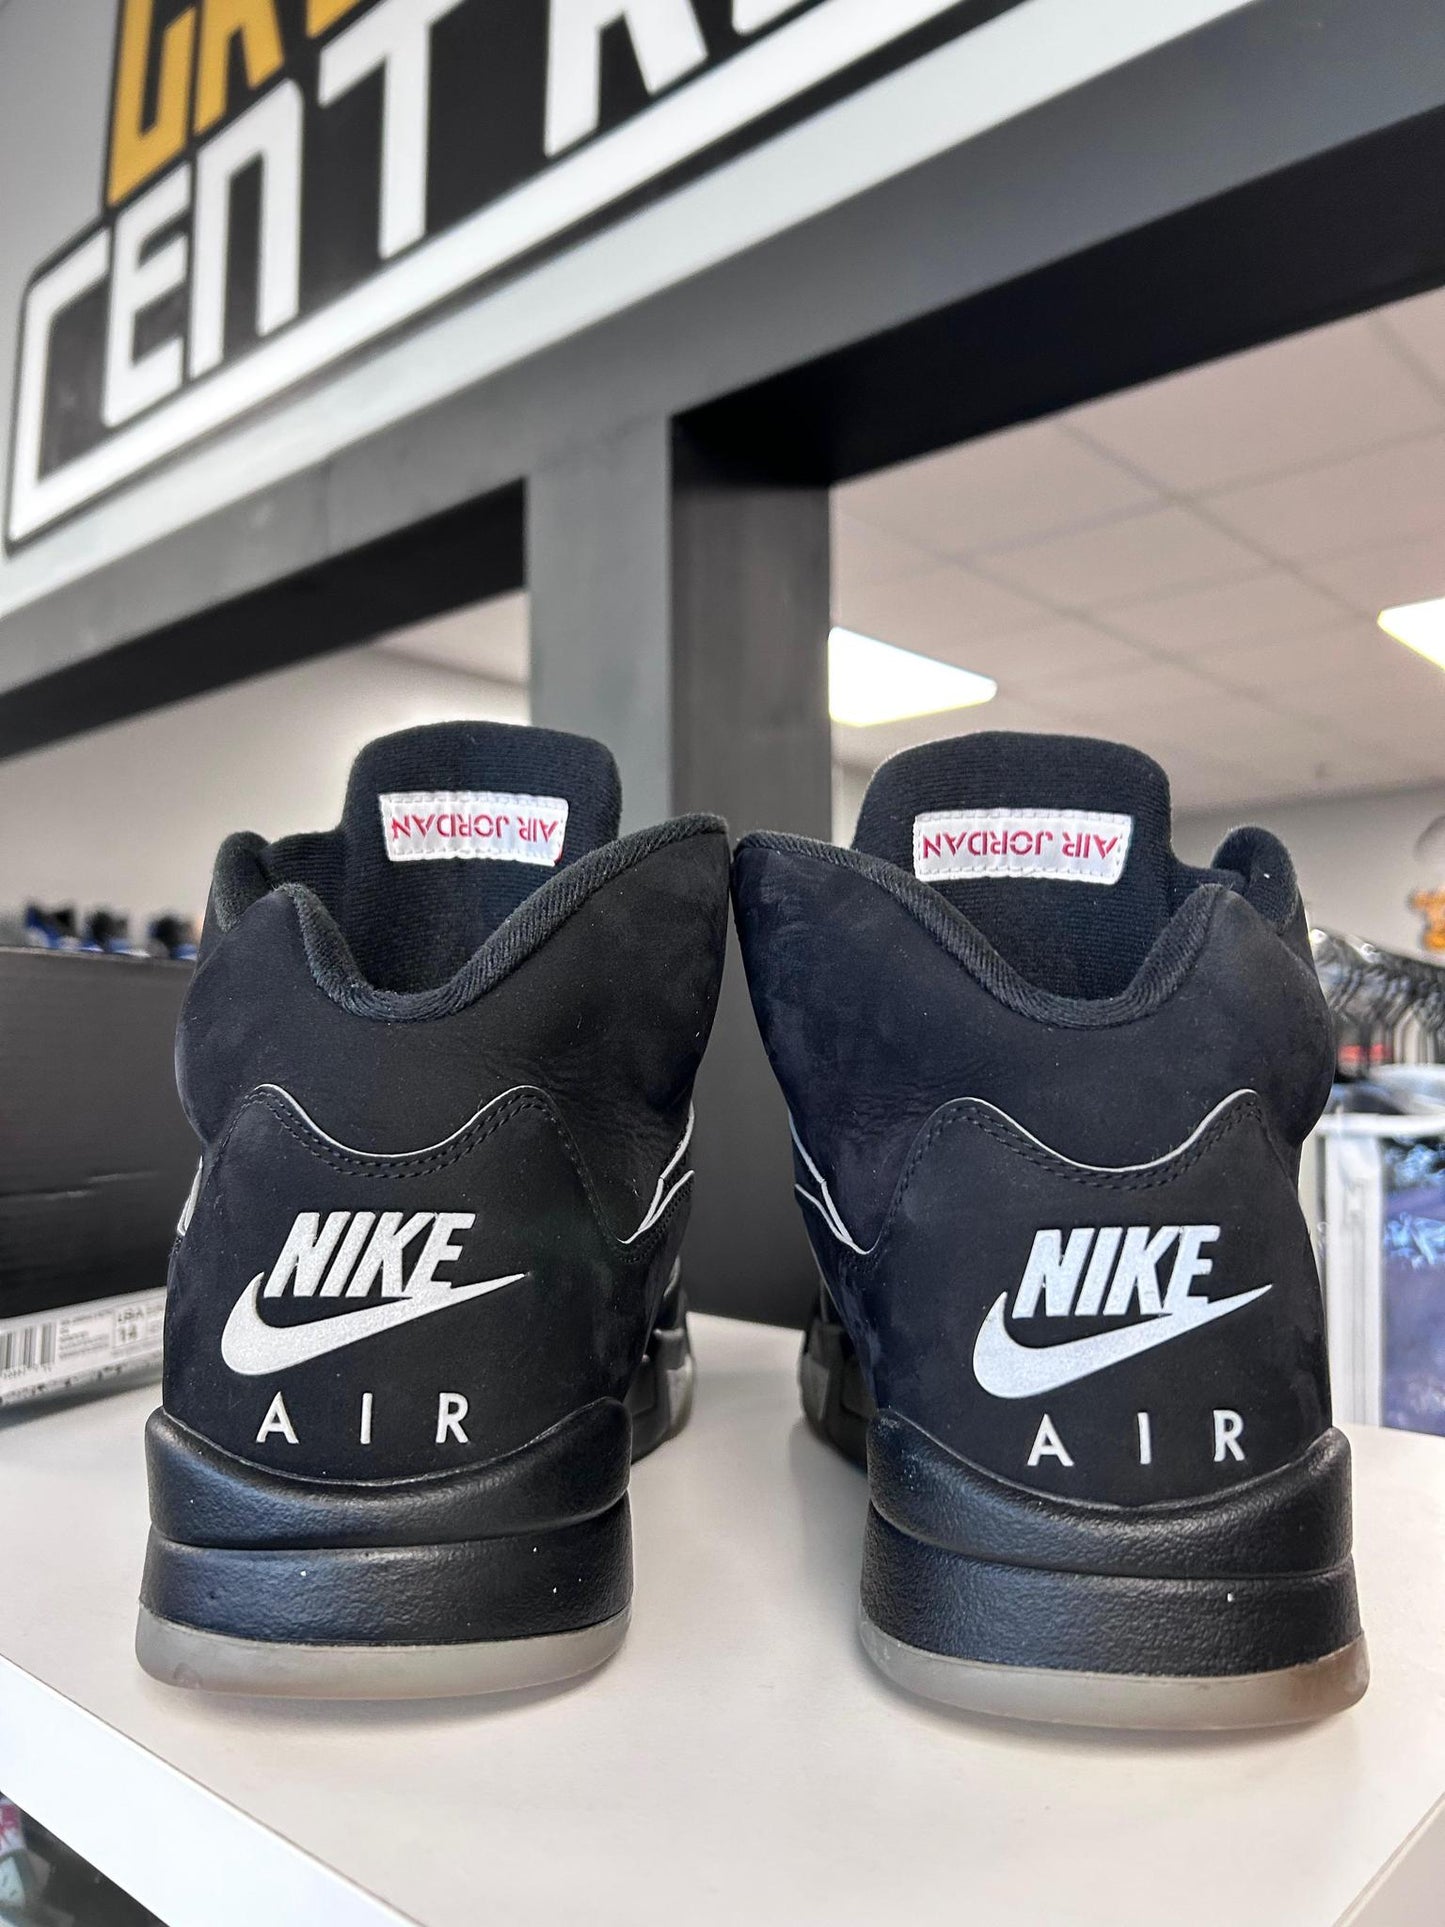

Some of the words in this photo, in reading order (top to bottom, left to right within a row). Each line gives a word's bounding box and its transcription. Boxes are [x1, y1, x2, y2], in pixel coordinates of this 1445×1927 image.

[391, 813, 510, 841] JORDAN
[518, 816, 559, 843] AIR
[922, 830, 1054, 860] JORDAN
[1062, 832, 1119, 860] AIR
[263, 1211, 477, 1298] NIKE
[1011, 1225, 1221, 1319] NIKE
[256, 1391, 471, 1445] AIR
[1026, 1409, 1246, 1467] AIR
